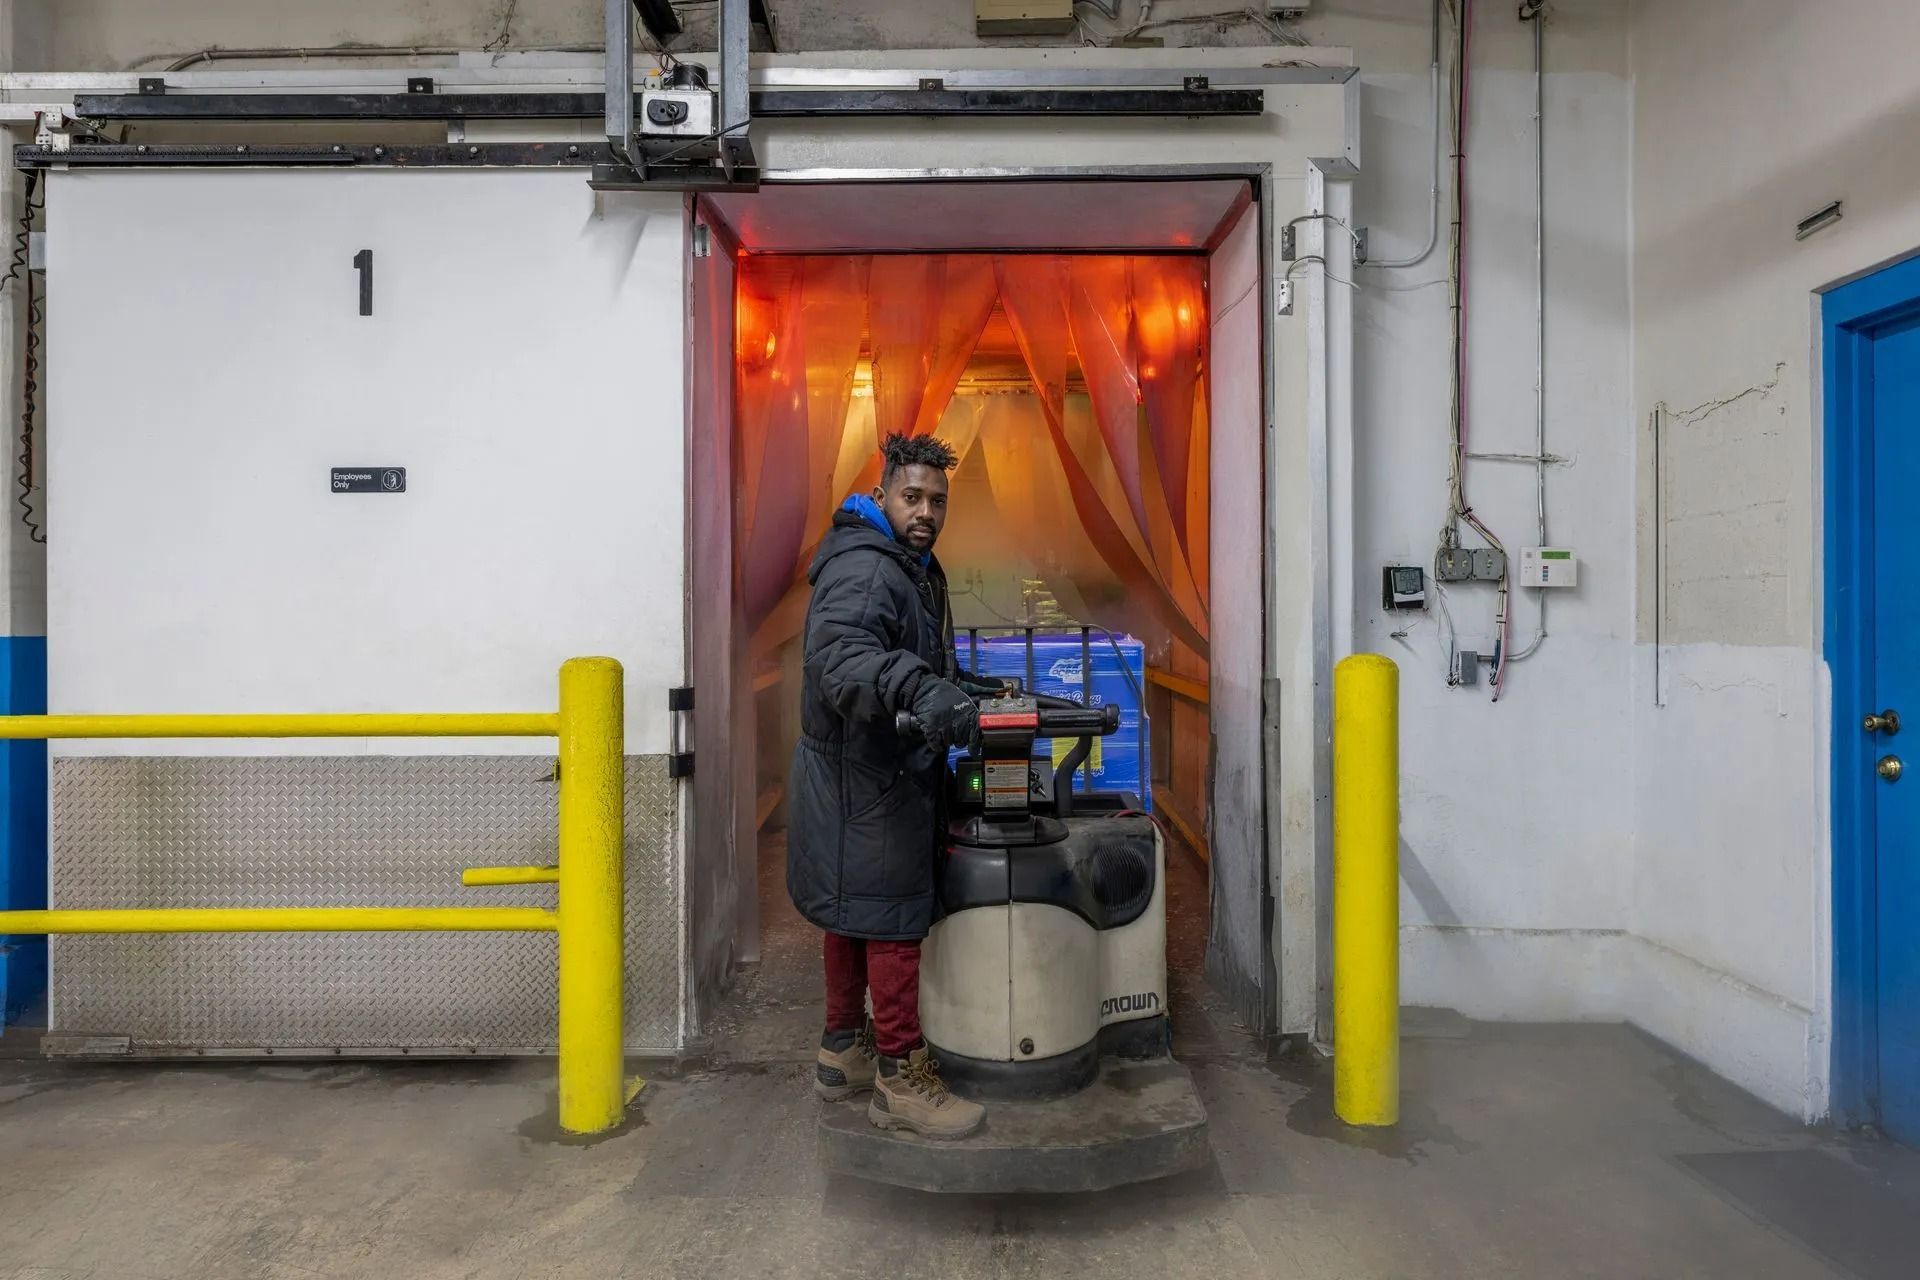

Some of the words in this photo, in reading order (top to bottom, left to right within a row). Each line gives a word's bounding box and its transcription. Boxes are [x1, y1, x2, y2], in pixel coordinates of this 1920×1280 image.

[354, 250, 373, 316] 1
[333, 473, 372, 481] Employees
[333, 481, 350, 489] Only
[1101, 992, 1160, 1017] CROWN
